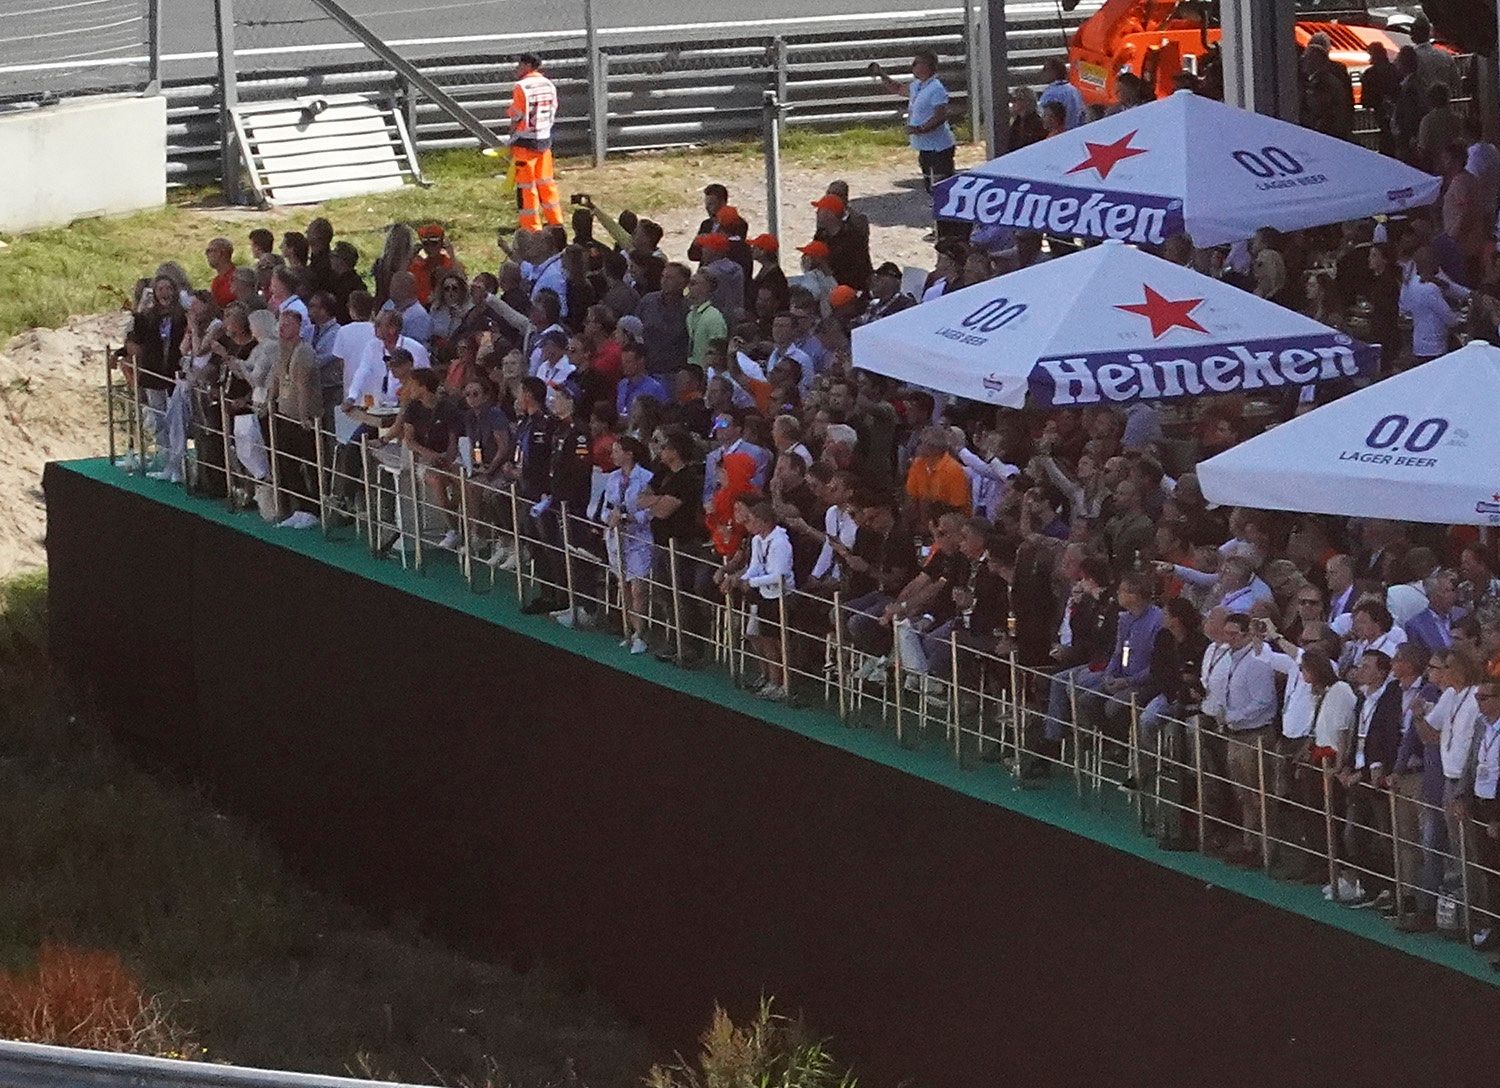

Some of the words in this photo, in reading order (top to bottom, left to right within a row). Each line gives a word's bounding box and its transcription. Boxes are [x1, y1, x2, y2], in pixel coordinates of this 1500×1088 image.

[939, 175, 1166, 246] Heineken
[1037, 345, 1360, 405] Heineken
[1366, 414, 1449, 453] 0.0
[1338, 450, 1393, 465] LAGER
[1394, 456, 1438, 468] BEER
